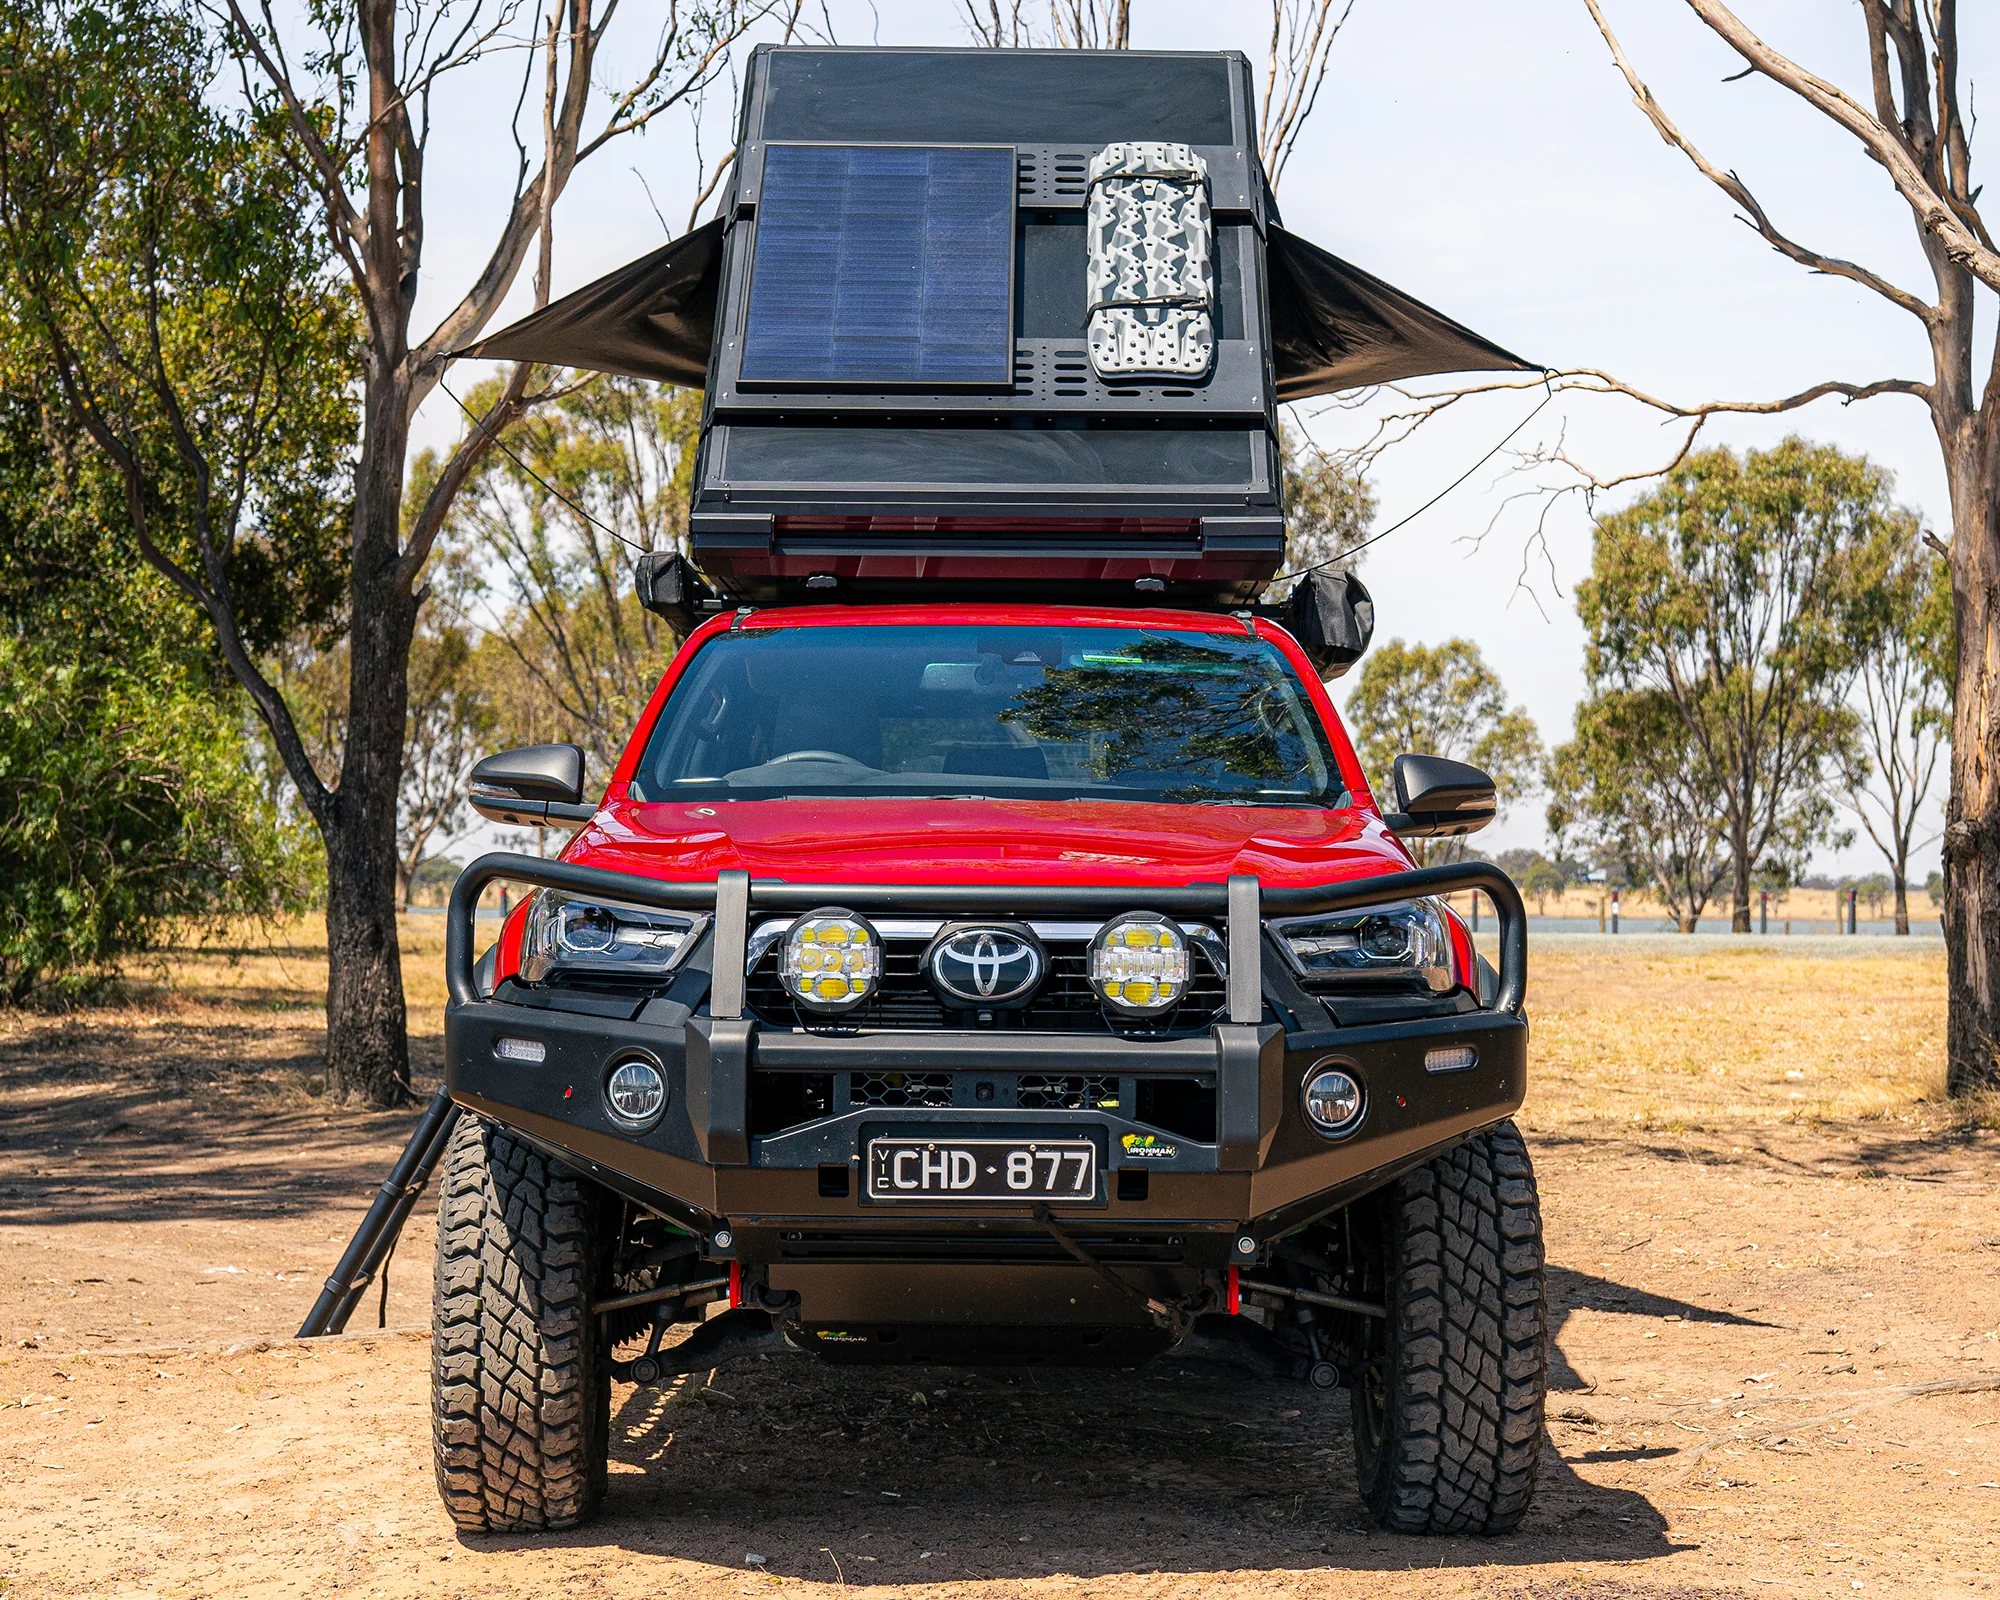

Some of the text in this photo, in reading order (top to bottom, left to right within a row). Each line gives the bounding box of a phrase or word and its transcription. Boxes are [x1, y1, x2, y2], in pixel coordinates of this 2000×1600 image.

[877, 1149, 890, 1188] VIC
[894, 1151, 1090, 1190] CHD 877
